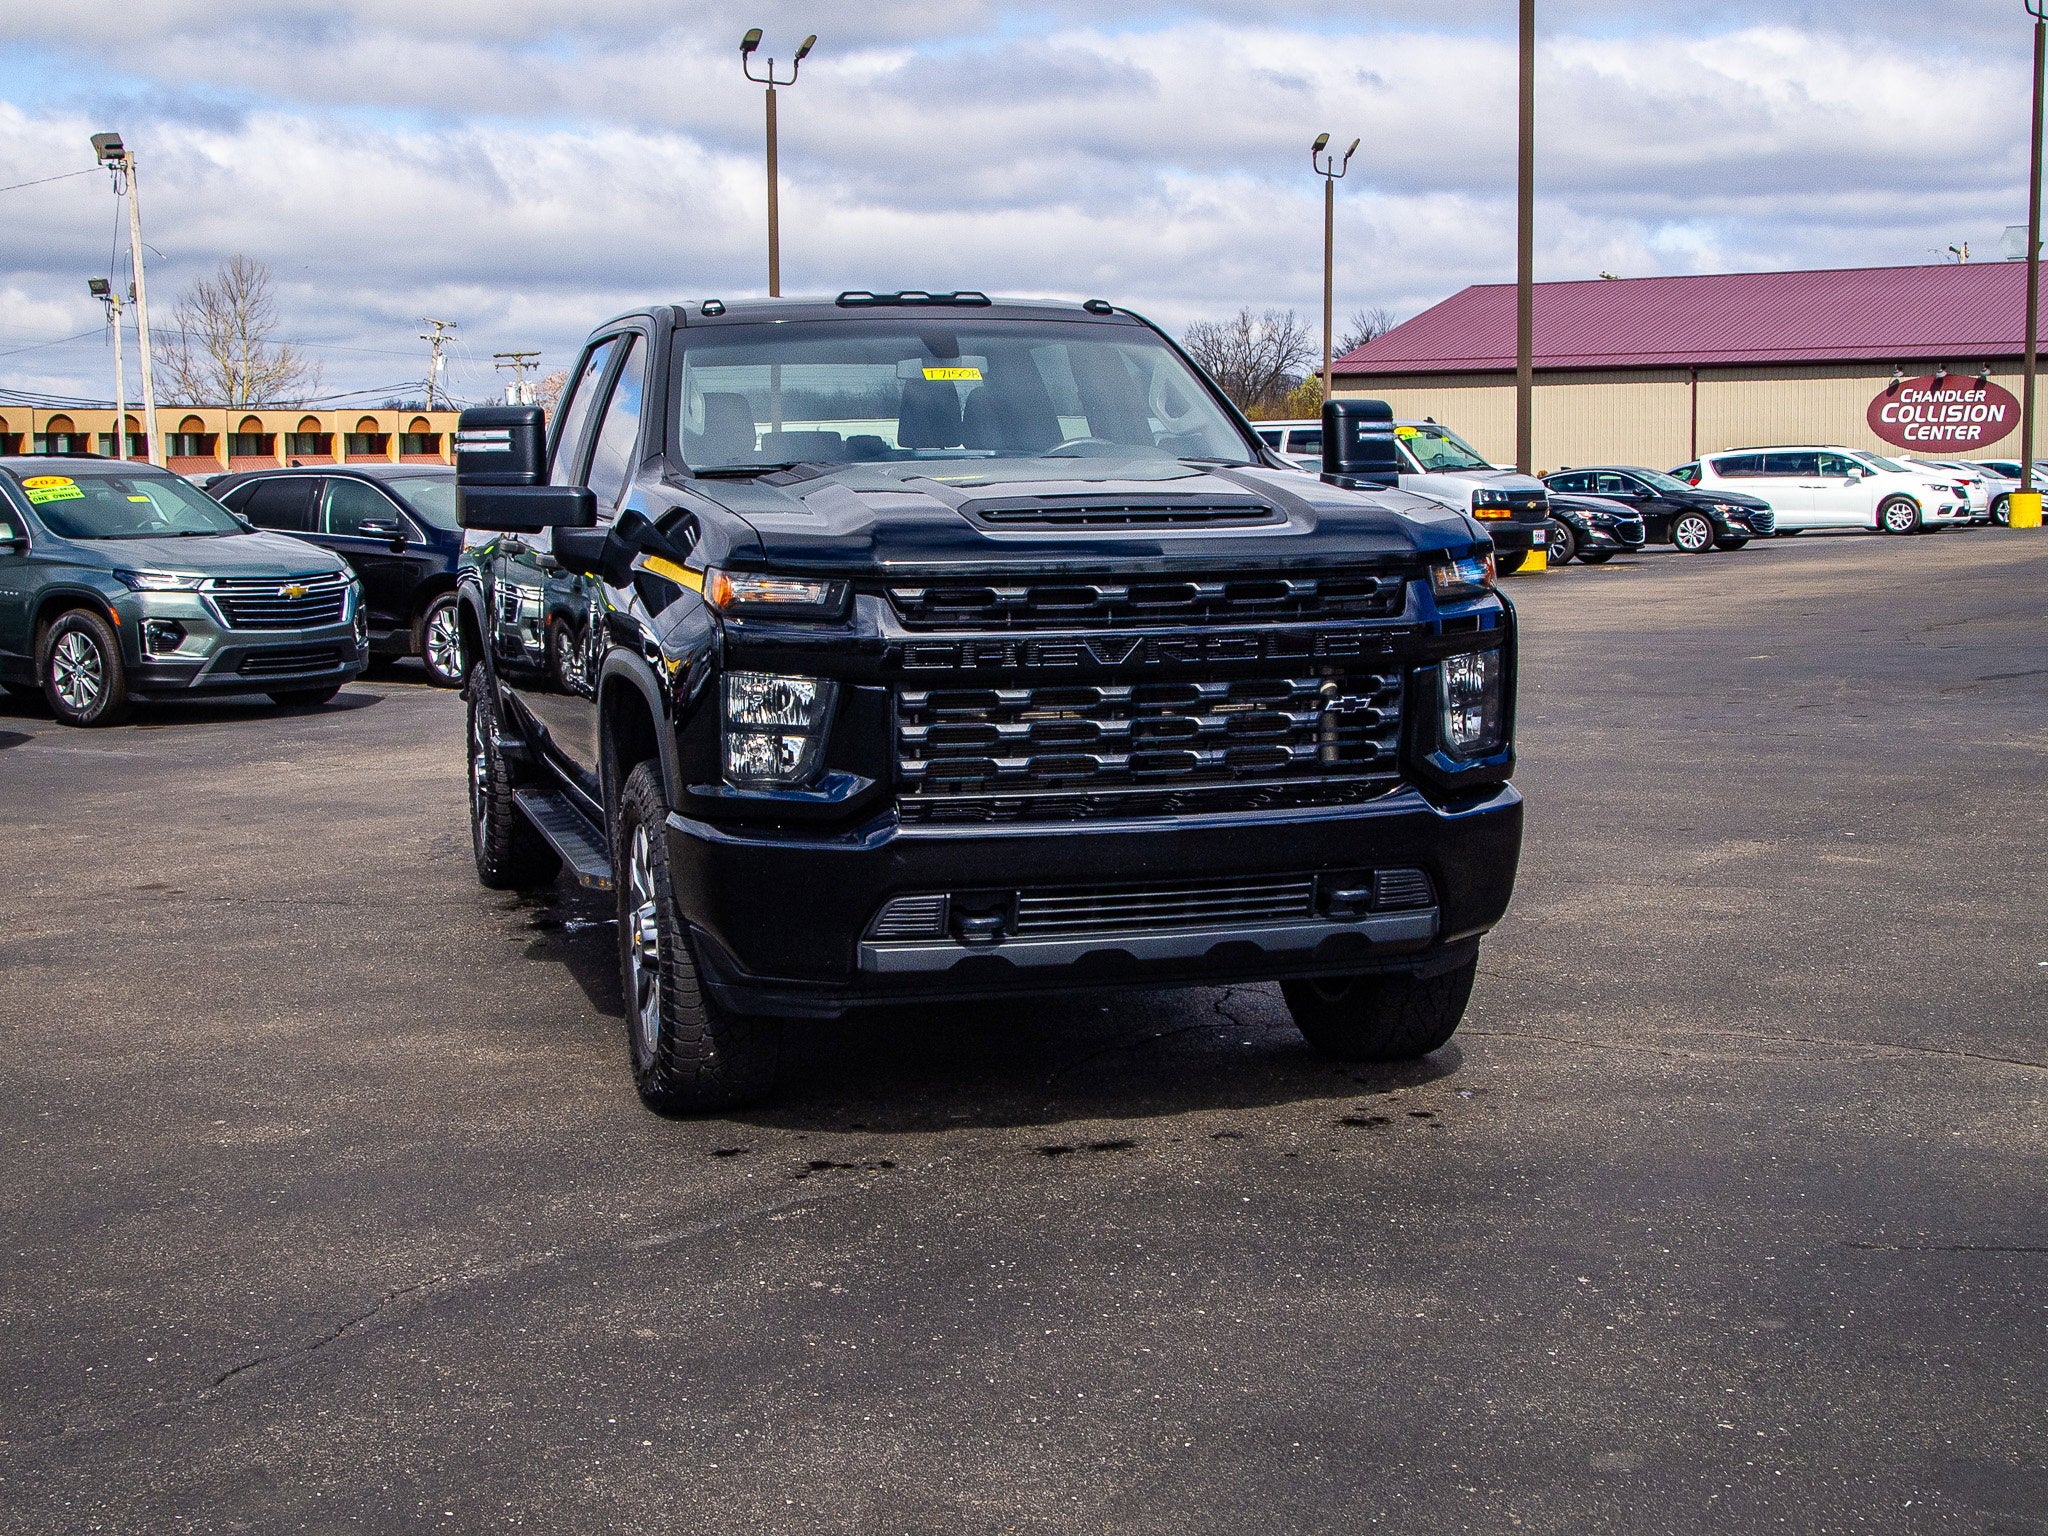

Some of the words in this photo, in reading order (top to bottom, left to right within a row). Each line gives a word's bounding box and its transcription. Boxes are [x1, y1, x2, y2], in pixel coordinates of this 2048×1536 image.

[1900, 388, 1987, 403] CHANDLER
[1880, 402, 2006, 423] COLLISION
[1903, 423, 1982, 440] CENTER
[32, 495, 50, 503] ONE
[52, 491, 82, 500] OWNER
[903, 625, 1411, 669] CHEVROLET
